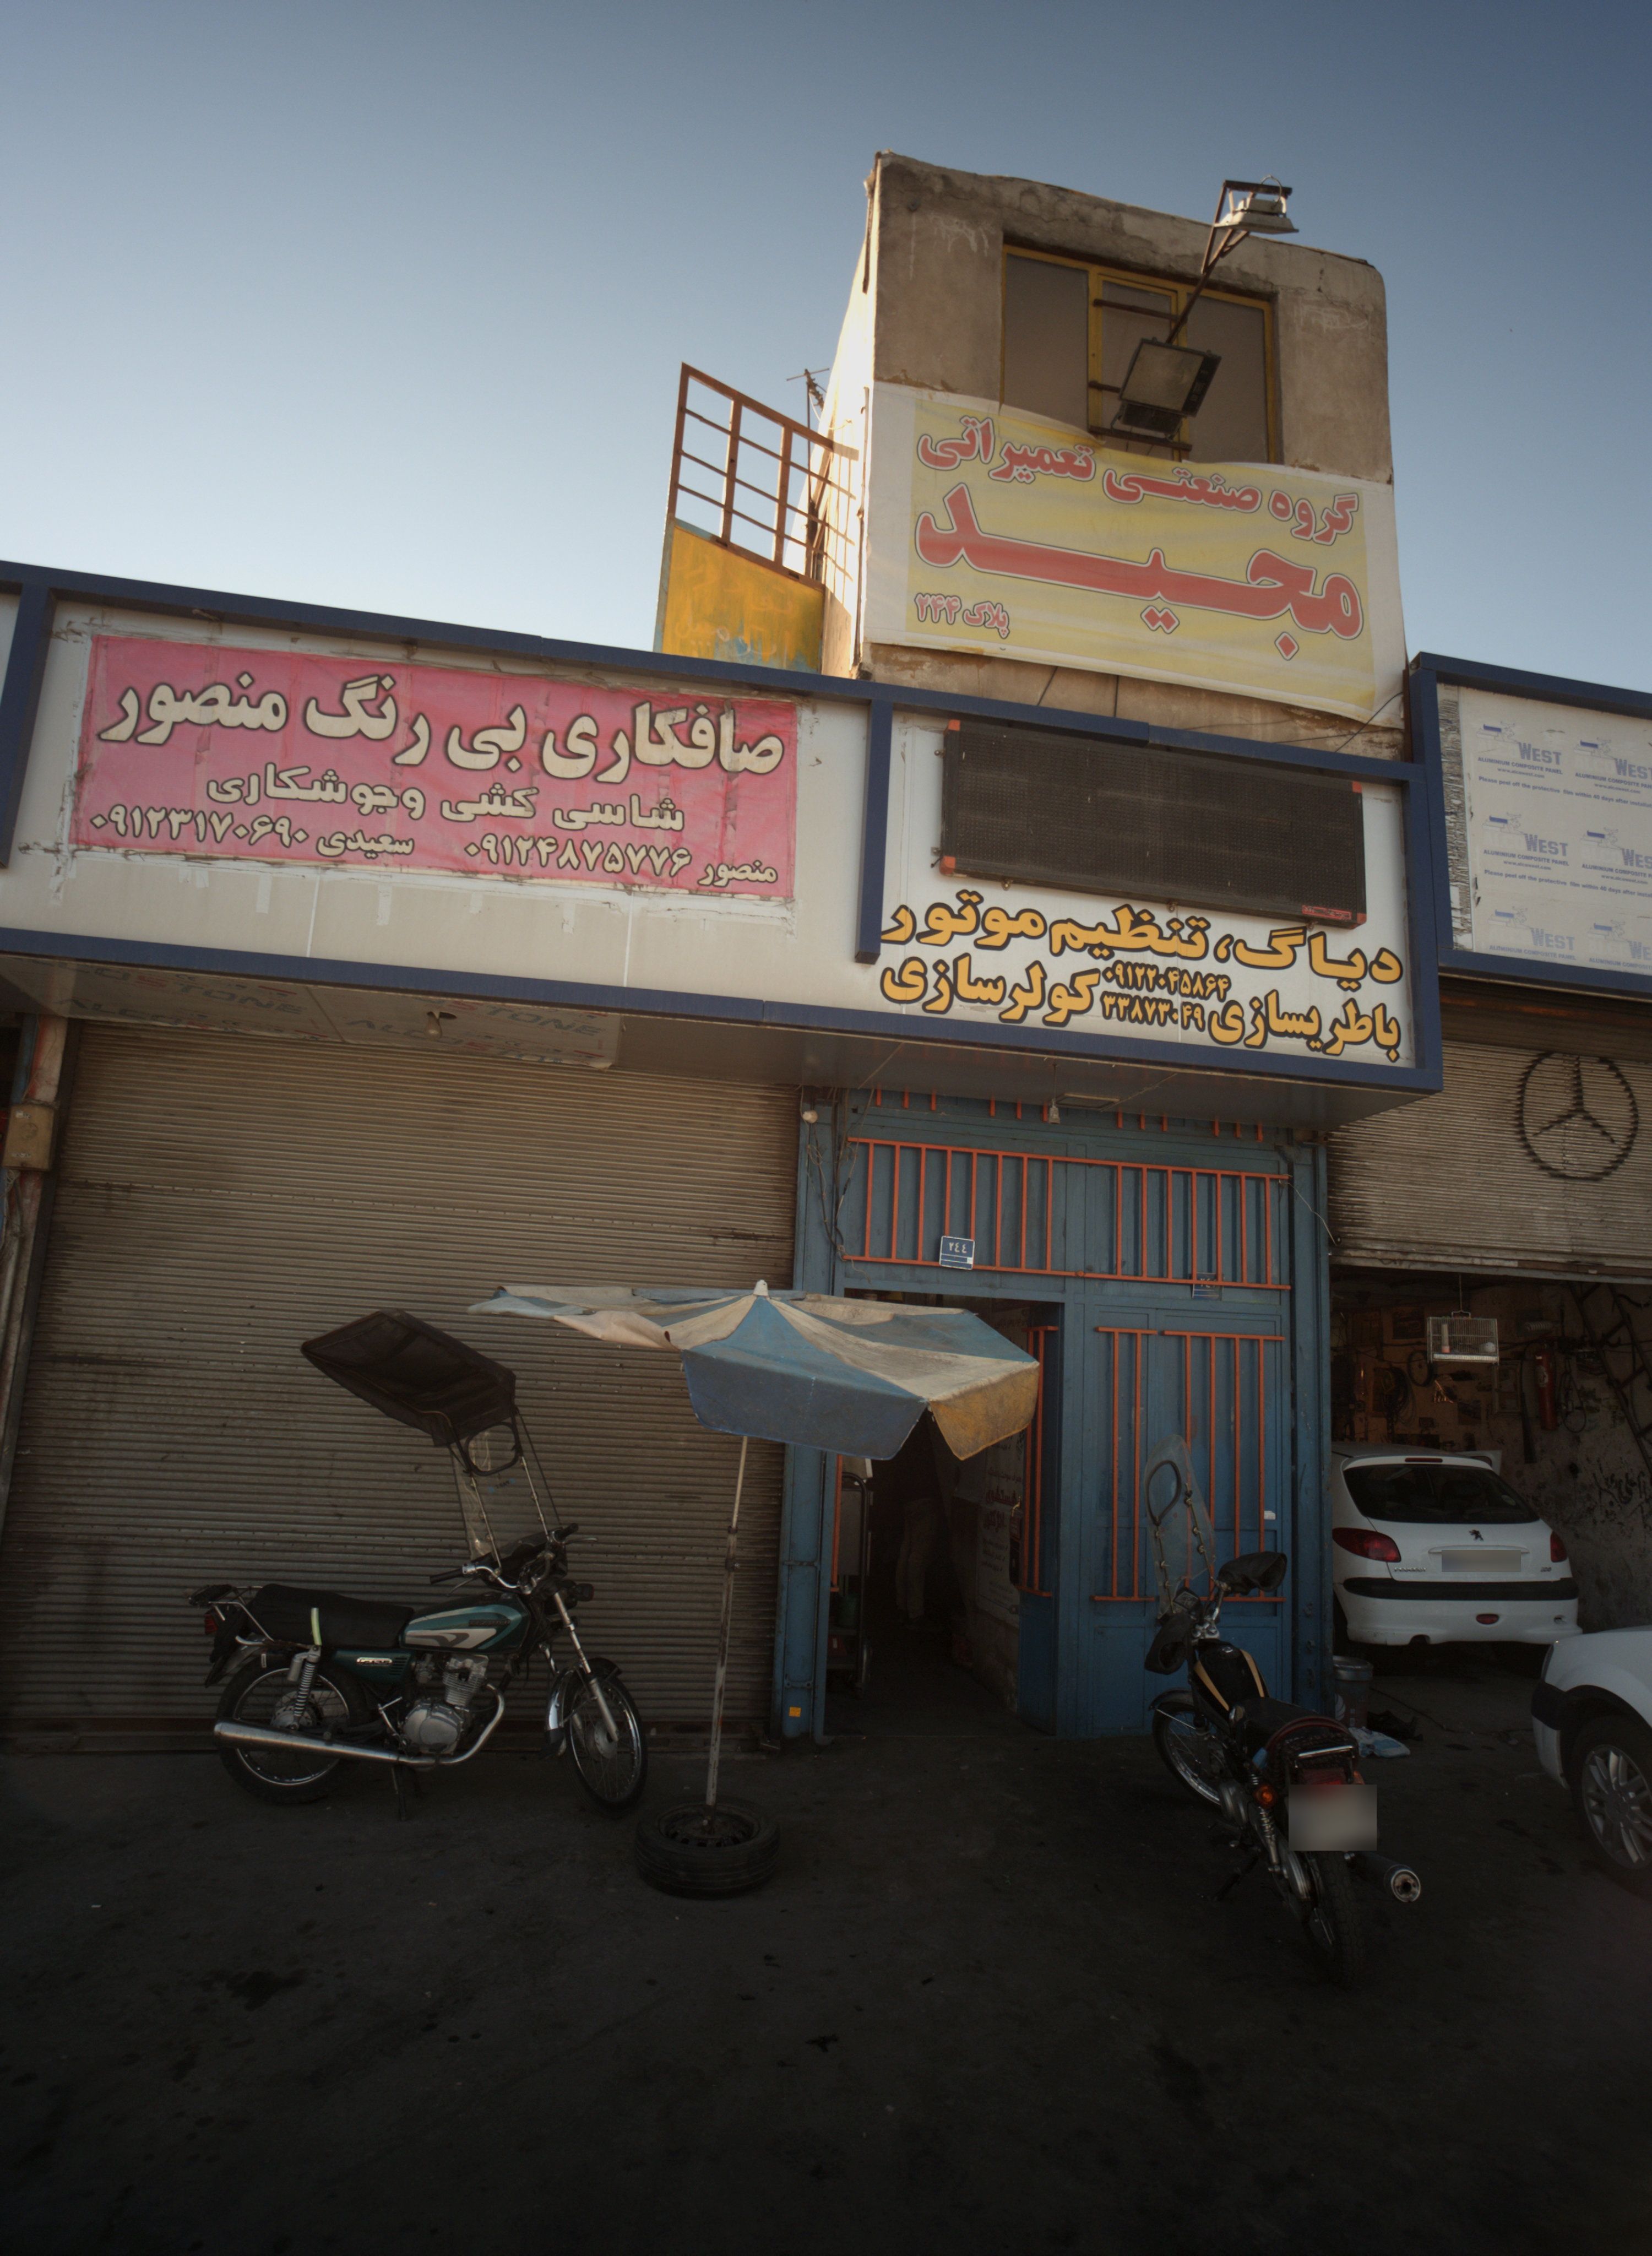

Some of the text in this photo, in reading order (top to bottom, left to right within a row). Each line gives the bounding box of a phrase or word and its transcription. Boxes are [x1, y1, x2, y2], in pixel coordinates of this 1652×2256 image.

[917, 415, 1360, 546] گروه صنعتی تعمیراتی
[915, 482, 1363, 660] مجید
[963, 602, 1009, 638] پلاک
[97, 671, 784, 784] صافکاری بی رنگ منصور
[1511, 762, 1543, 771] COMPOSITE
[1518, 742, 1561, 765] WEST
[441, 782, 539, 822] کشی
[553, 794, 684, 831] شاسی
[316, 829, 415, 859] سعیدی
[1517, 854, 1550, 864] COMPOSITE
[1524, 833, 1568, 856] WEST
[1621, 848, 1652, 870] WES
[698, 859, 778, 887] منصور
[881, 889, 1047, 950] موتور
[1049, 904, 1211, 961] تنظیم
[1530, 928, 1574, 951] WEST
